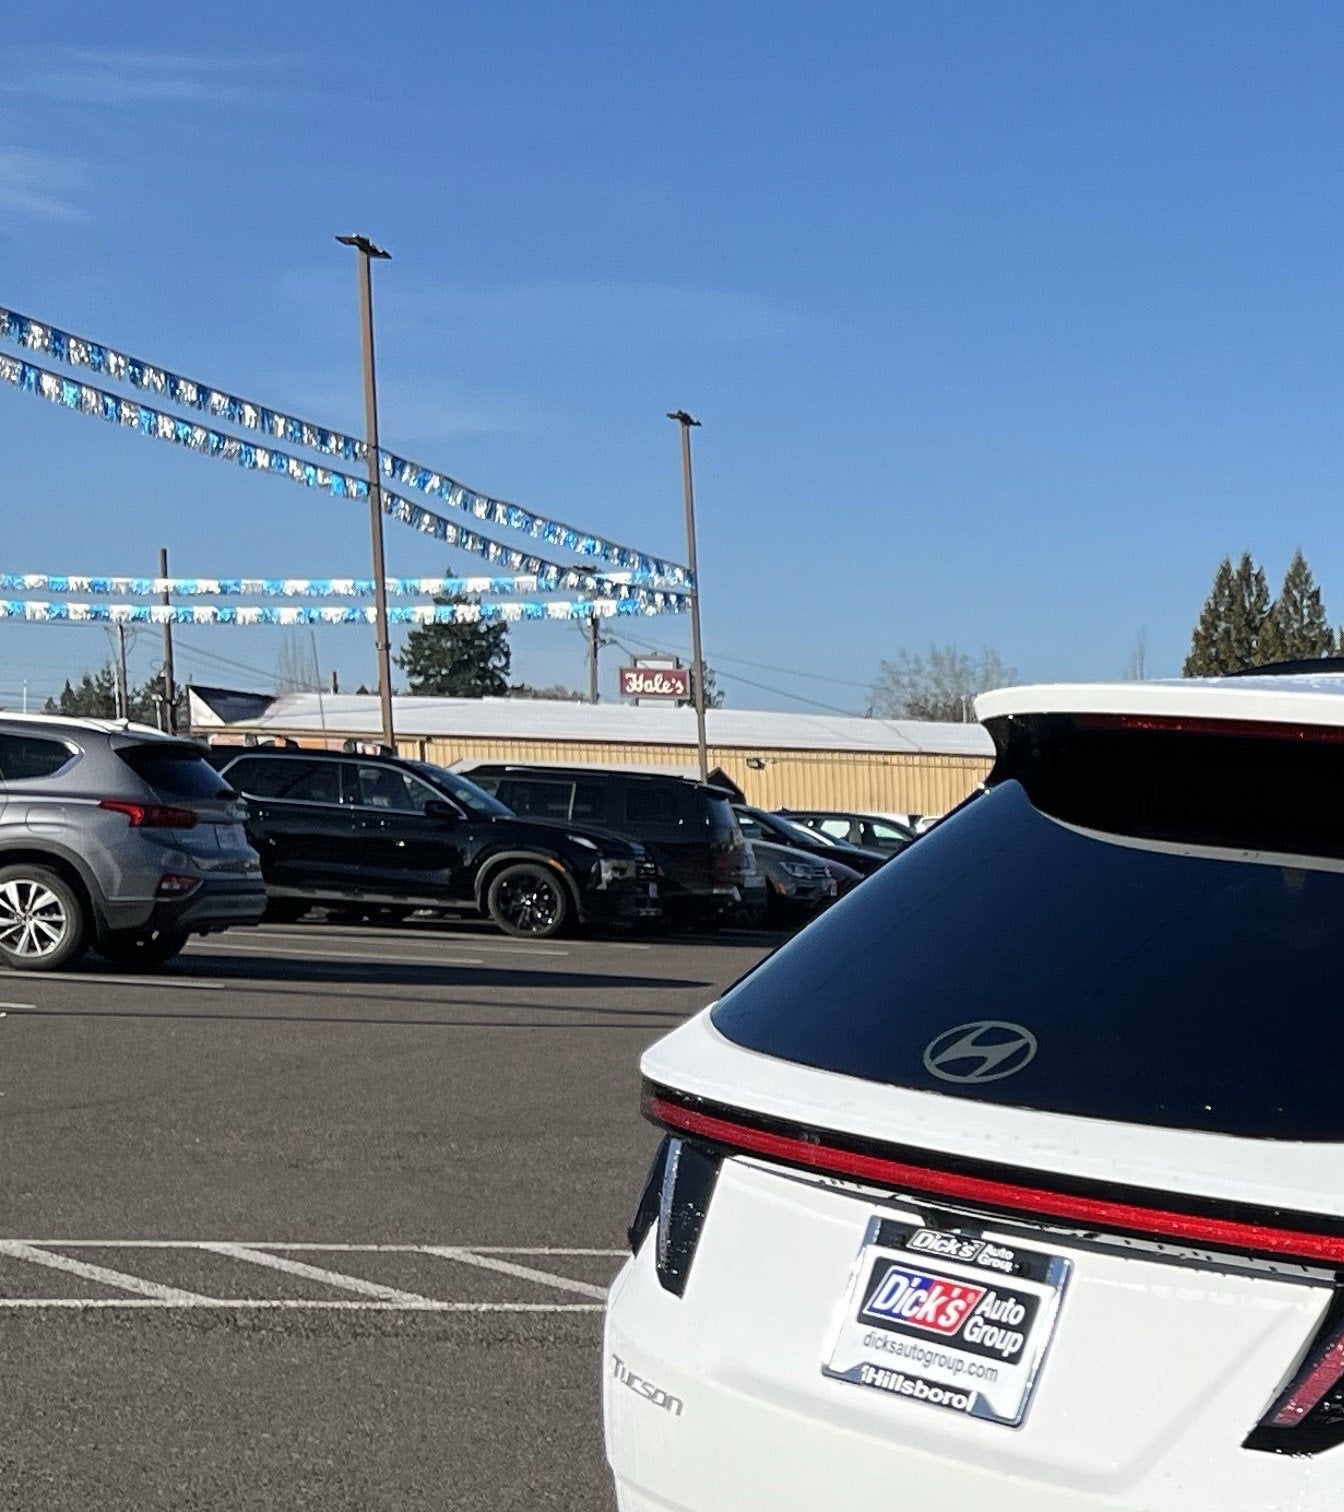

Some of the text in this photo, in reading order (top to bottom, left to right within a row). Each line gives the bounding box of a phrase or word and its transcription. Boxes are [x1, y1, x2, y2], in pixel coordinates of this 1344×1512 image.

[625, 672, 684, 694] Hale's
[912, 1231, 1014, 1260] Dick's Auto
[872, 1273, 1026, 1328] Dick's Auto
[863, 1331, 999, 1383] dicksautogroup.com
[963, 1315, 1024, 1358] Group
